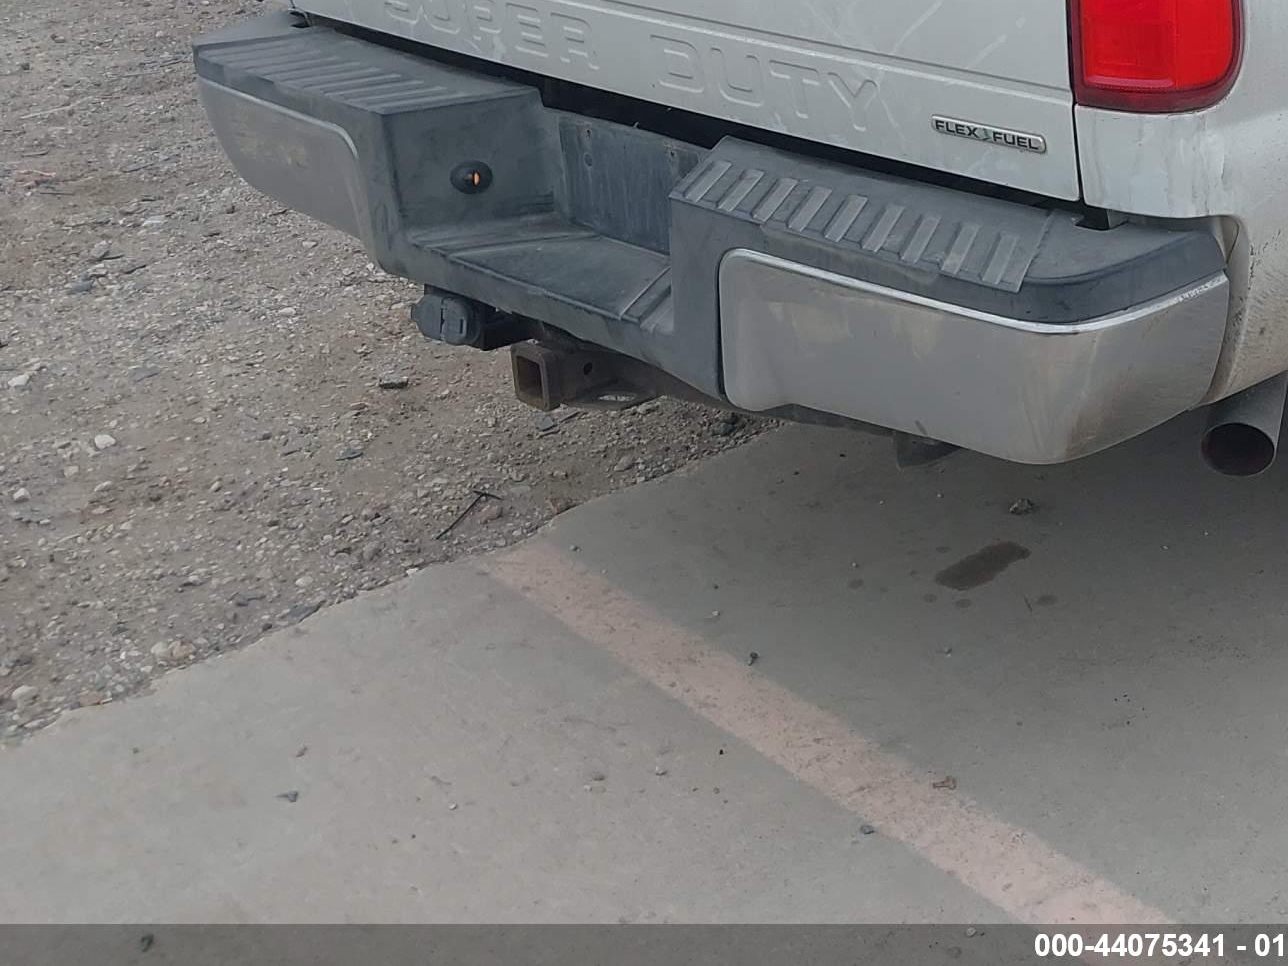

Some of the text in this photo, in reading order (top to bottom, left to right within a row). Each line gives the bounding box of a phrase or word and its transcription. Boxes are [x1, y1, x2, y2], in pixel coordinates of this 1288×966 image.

[648, 33, 881, 132] DUTY
[935, 119, 1040, 150] FLEX FUEL
